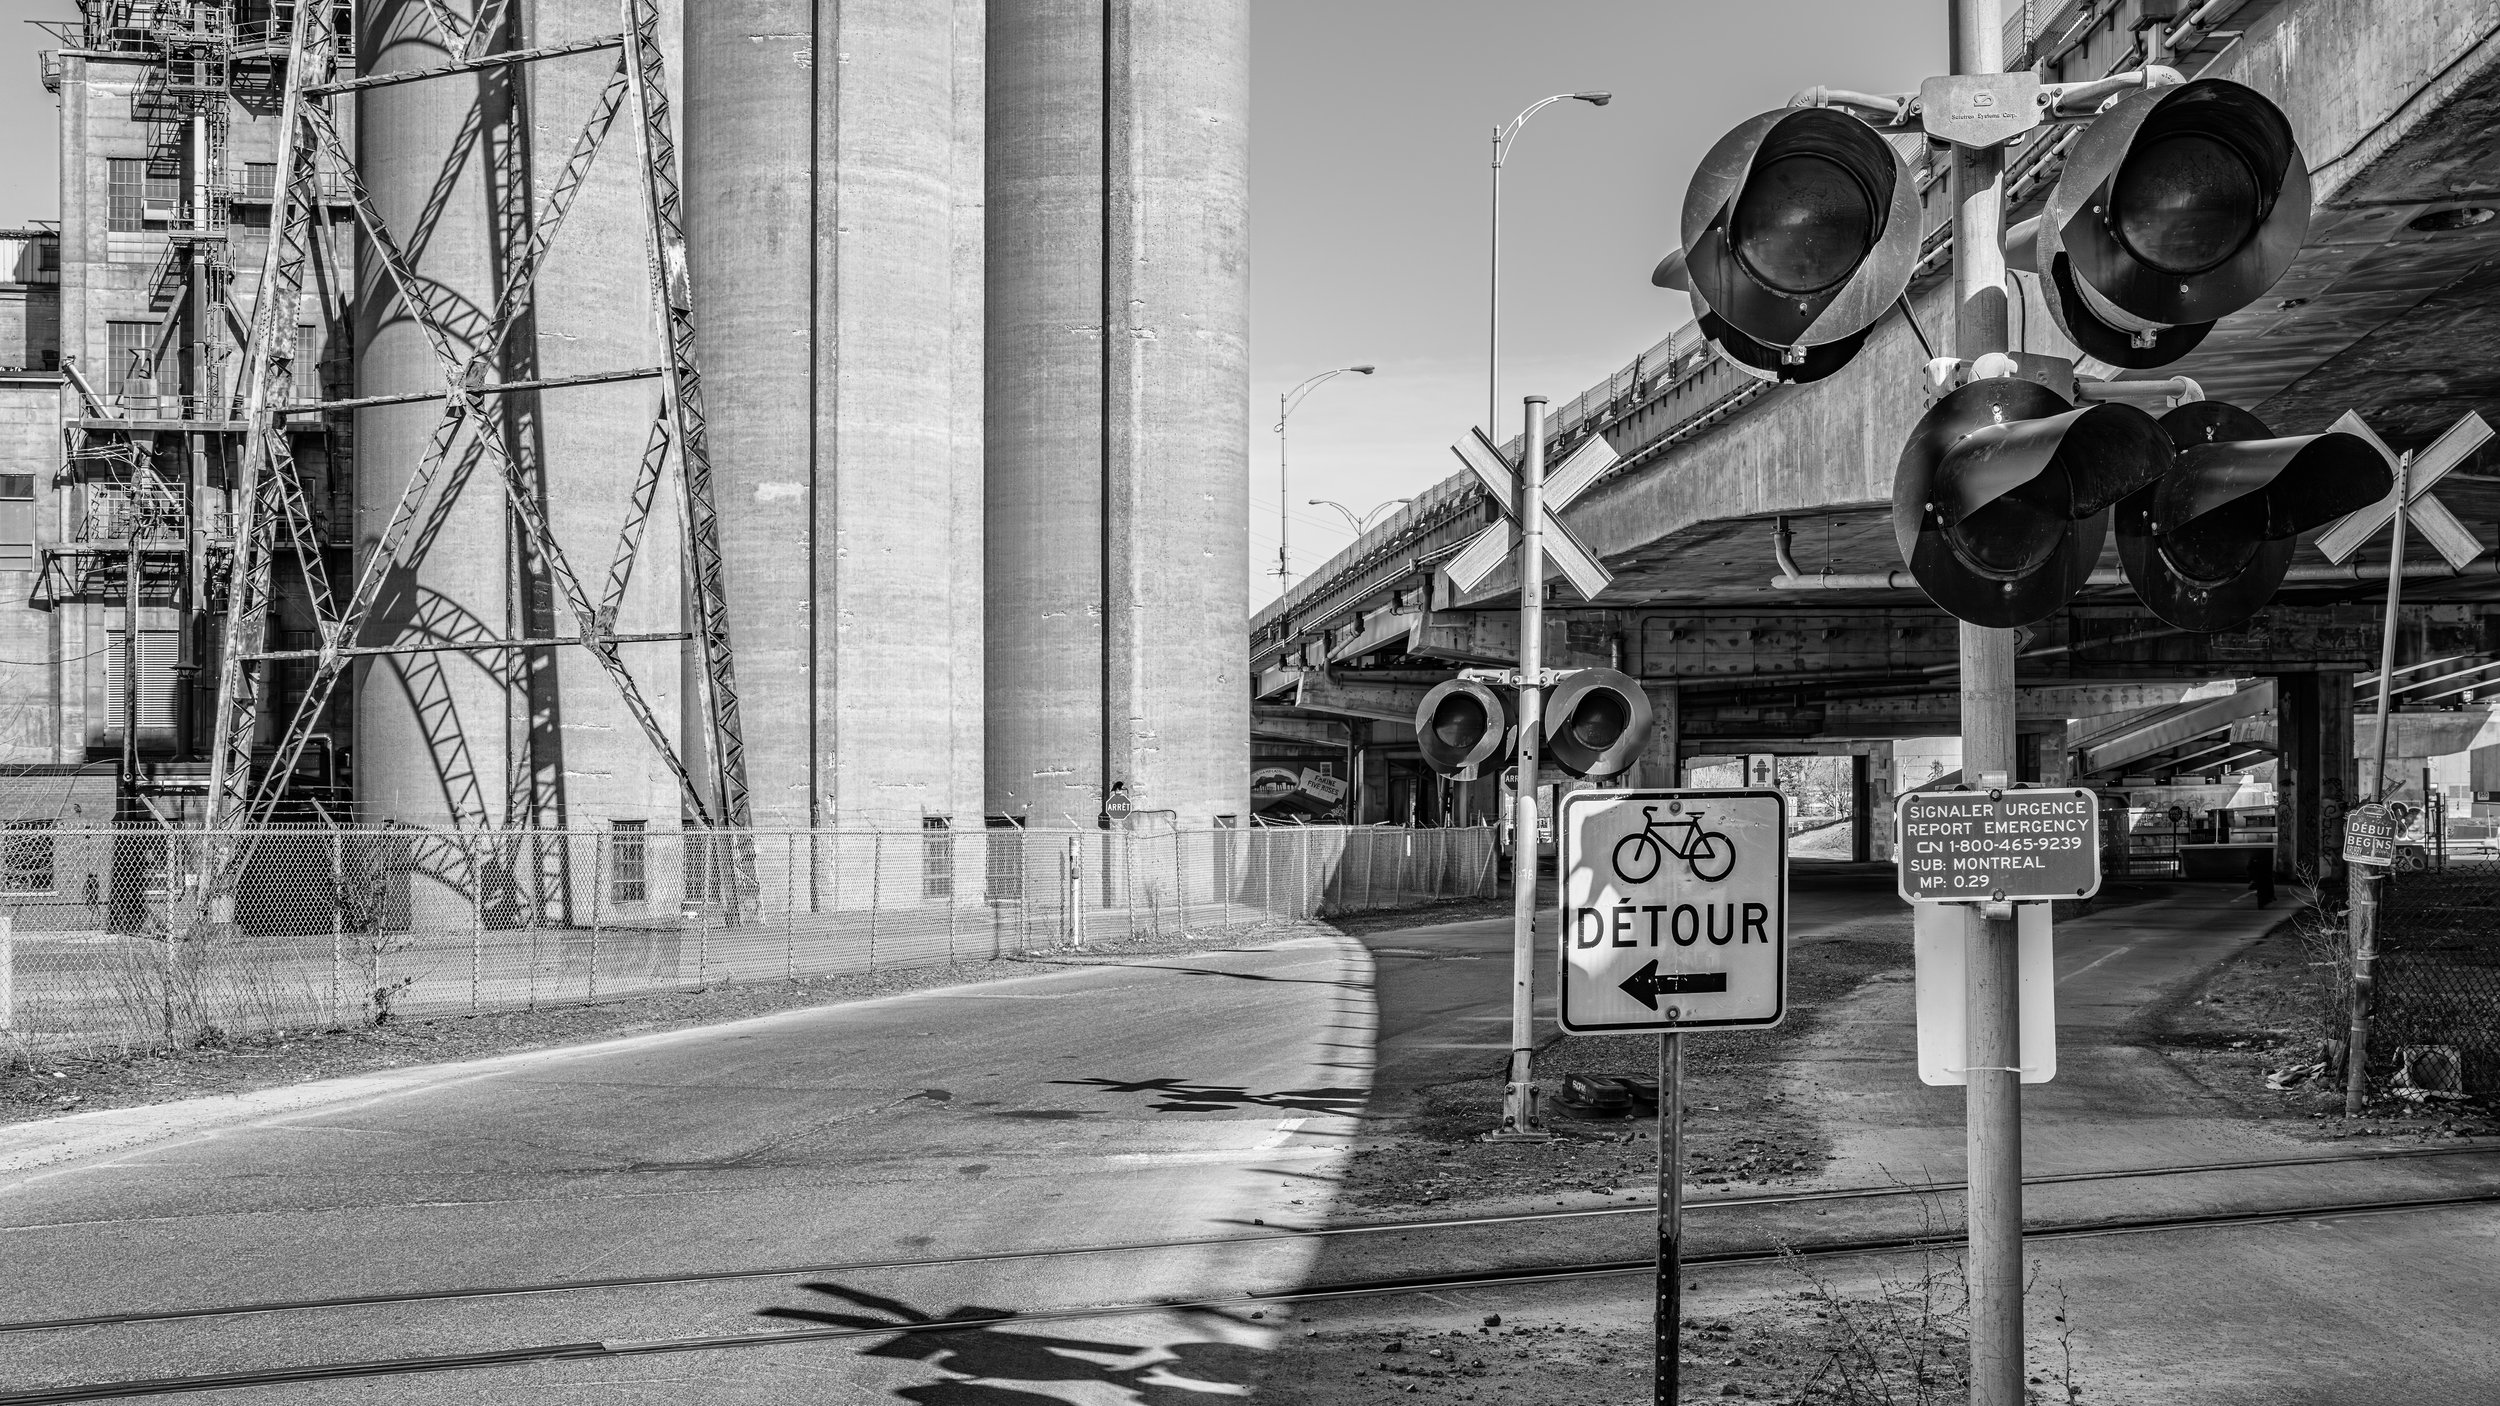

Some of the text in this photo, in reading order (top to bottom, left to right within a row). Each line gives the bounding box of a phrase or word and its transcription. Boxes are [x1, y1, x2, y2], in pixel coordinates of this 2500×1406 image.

[1307, 780, 1339, 796] FIVE ROSES
[1107, 802, 1130, 811] ARRÊT
[1910, 801, 2086, 819] SIGNALER URGENCE
[1907, 818, 2090, 836] REPORT EMERGENCY
[2351, 821, 2392, 836] DÉBUT
[1916, 837, 2082, 853] CN 1-800-465-9239
[1910, 856, 2046, 871] SUB: MONTREAL
[1920, 875, 1990, 888] MP: 0.29
[1577, 897, 1769, 949] DÉTOUR
